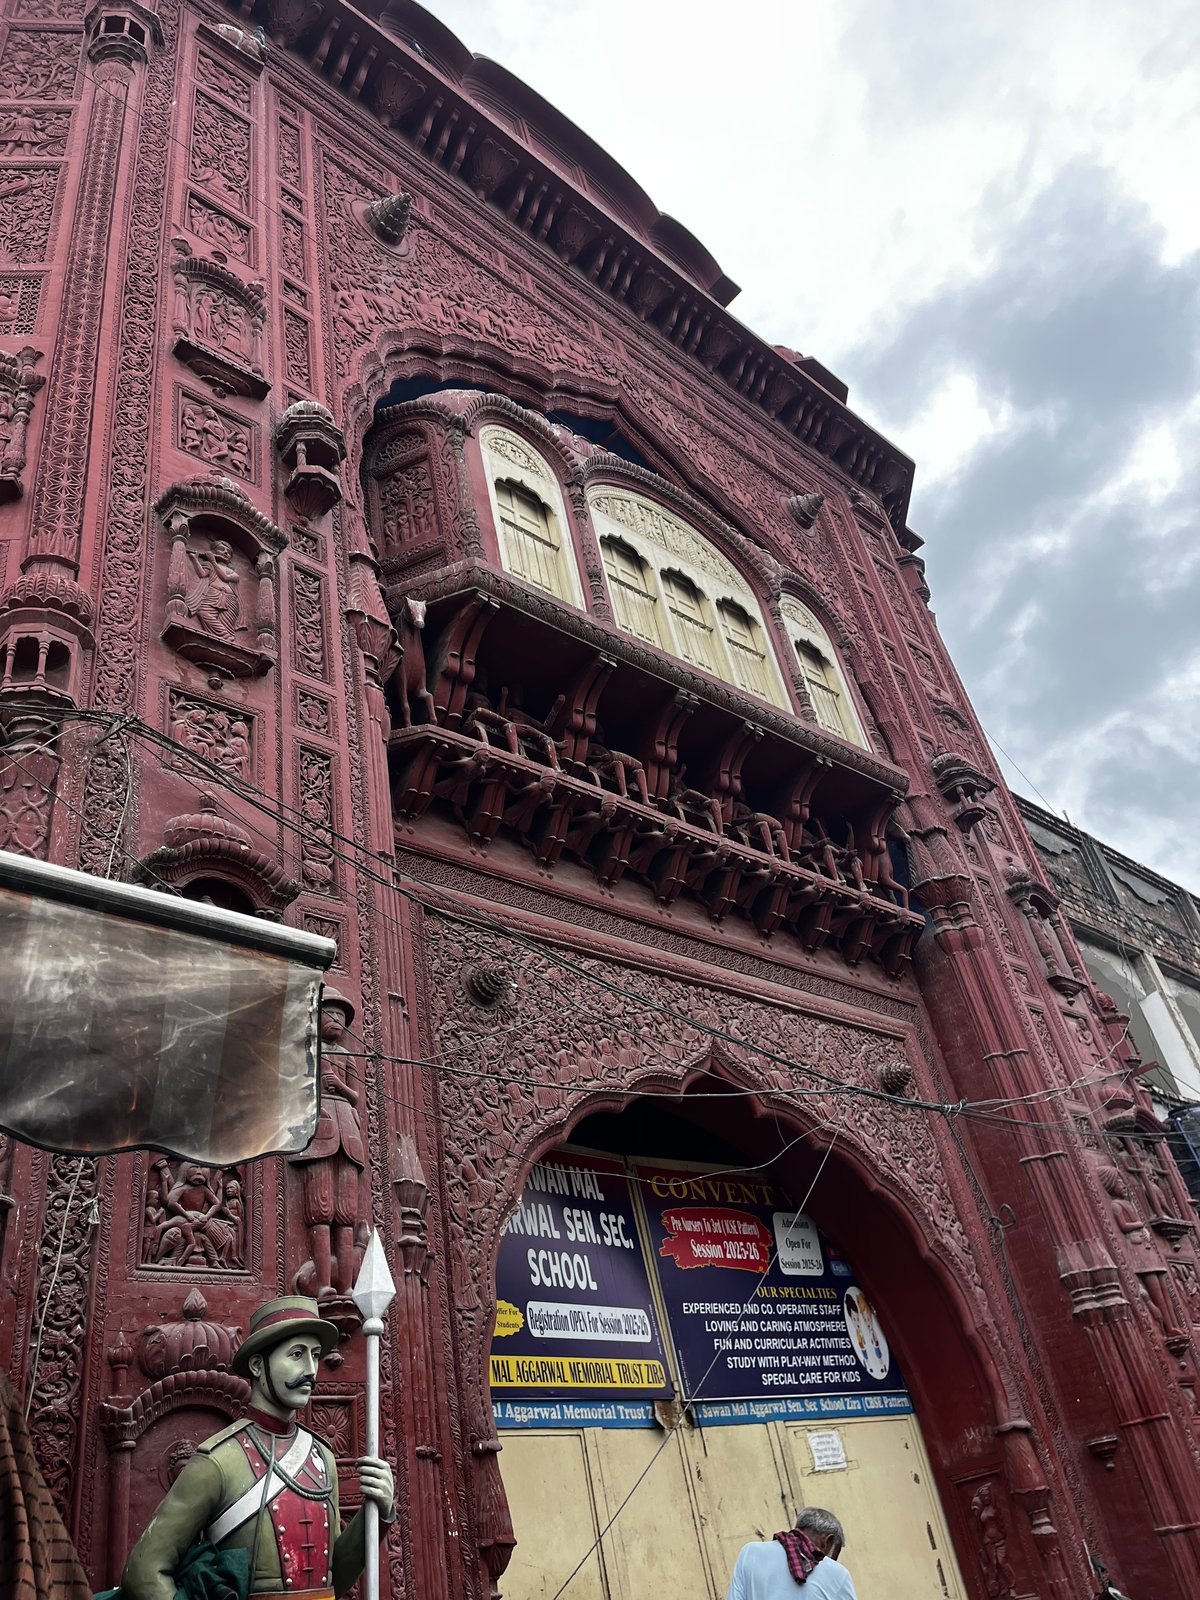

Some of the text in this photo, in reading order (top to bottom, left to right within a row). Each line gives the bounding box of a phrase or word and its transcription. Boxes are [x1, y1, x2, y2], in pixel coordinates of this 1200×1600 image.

[569, 1164, 605, 1201] MAL
[651, 1175, 775, 1206] CONVENT
[563, 1206, 601, 1245] SEN.
[600, 1212, 634, 1249] SEC.
[670, 1215, 682, 1231] Pre
[681, 1216, 704, 1236] Nursery
[702, 1217, 711, 1233] To
[710, 1218, 722, 1233] 3rd
[690, 1238, 760, 1260] Session 2025-26
[785, 1237, 811, 1251] Open For
[527, 1248, 598, 1290] SCHOOL
[780, 1257, 823, 1270] Session 2025-26
[756, 1286, 837, 1299] OUR SPECIALTIES
[508, 1308, 518, 1316] For
[682, 1303, 841, 1315] EXPERIENCED AND CO. OPERATIVE STAFF
[496, 1320, 520, 1329] Students
[528, 1307, 570, 1336] Registration
[569, 1310, 588, 1332] OPEN
[587, 1311, 599, 1333] For
[599, 1312, 624, 1334] Session
[622, 1313, 649, 1336] 2025-26
[705, 1320, 847, 1332] LOVING AND CARING ATMOSPHERE
[714, 1337, 851, 1350] FUN AND CURRICULAR ACTIVITIES
[727, 1355, 856, 1369] STUDY WITH PLAY-WAY METHOD
[491, 1359, 514, 1383] MAL
[515, 1360, 568, 1383] AGGARWAL
[568, 1361, 617, 1384] MEMORIAL
[615, 1363, 644, 1384] TRUST
[644, 1363, 665, 1385] ZIRA
[762, 1371, 861, 1385] SPECIAL CARE FOR KIDS
[505, 1402, 561, 1423] Aggarwal
[562, 1404, 617, 1420] Memorial
[617, 1405, 646, 1420] Trust
[702, 1404, 731, 1418] Sawan
[731, 1402, 748, 1416] Mal
[749, 1400, 787, 1418] Aggarwal
[786, 1399, 804, 1412] Sen.
[819, 1398, 845, 1411] School
[844, 1396, 861, 1409] Zira
